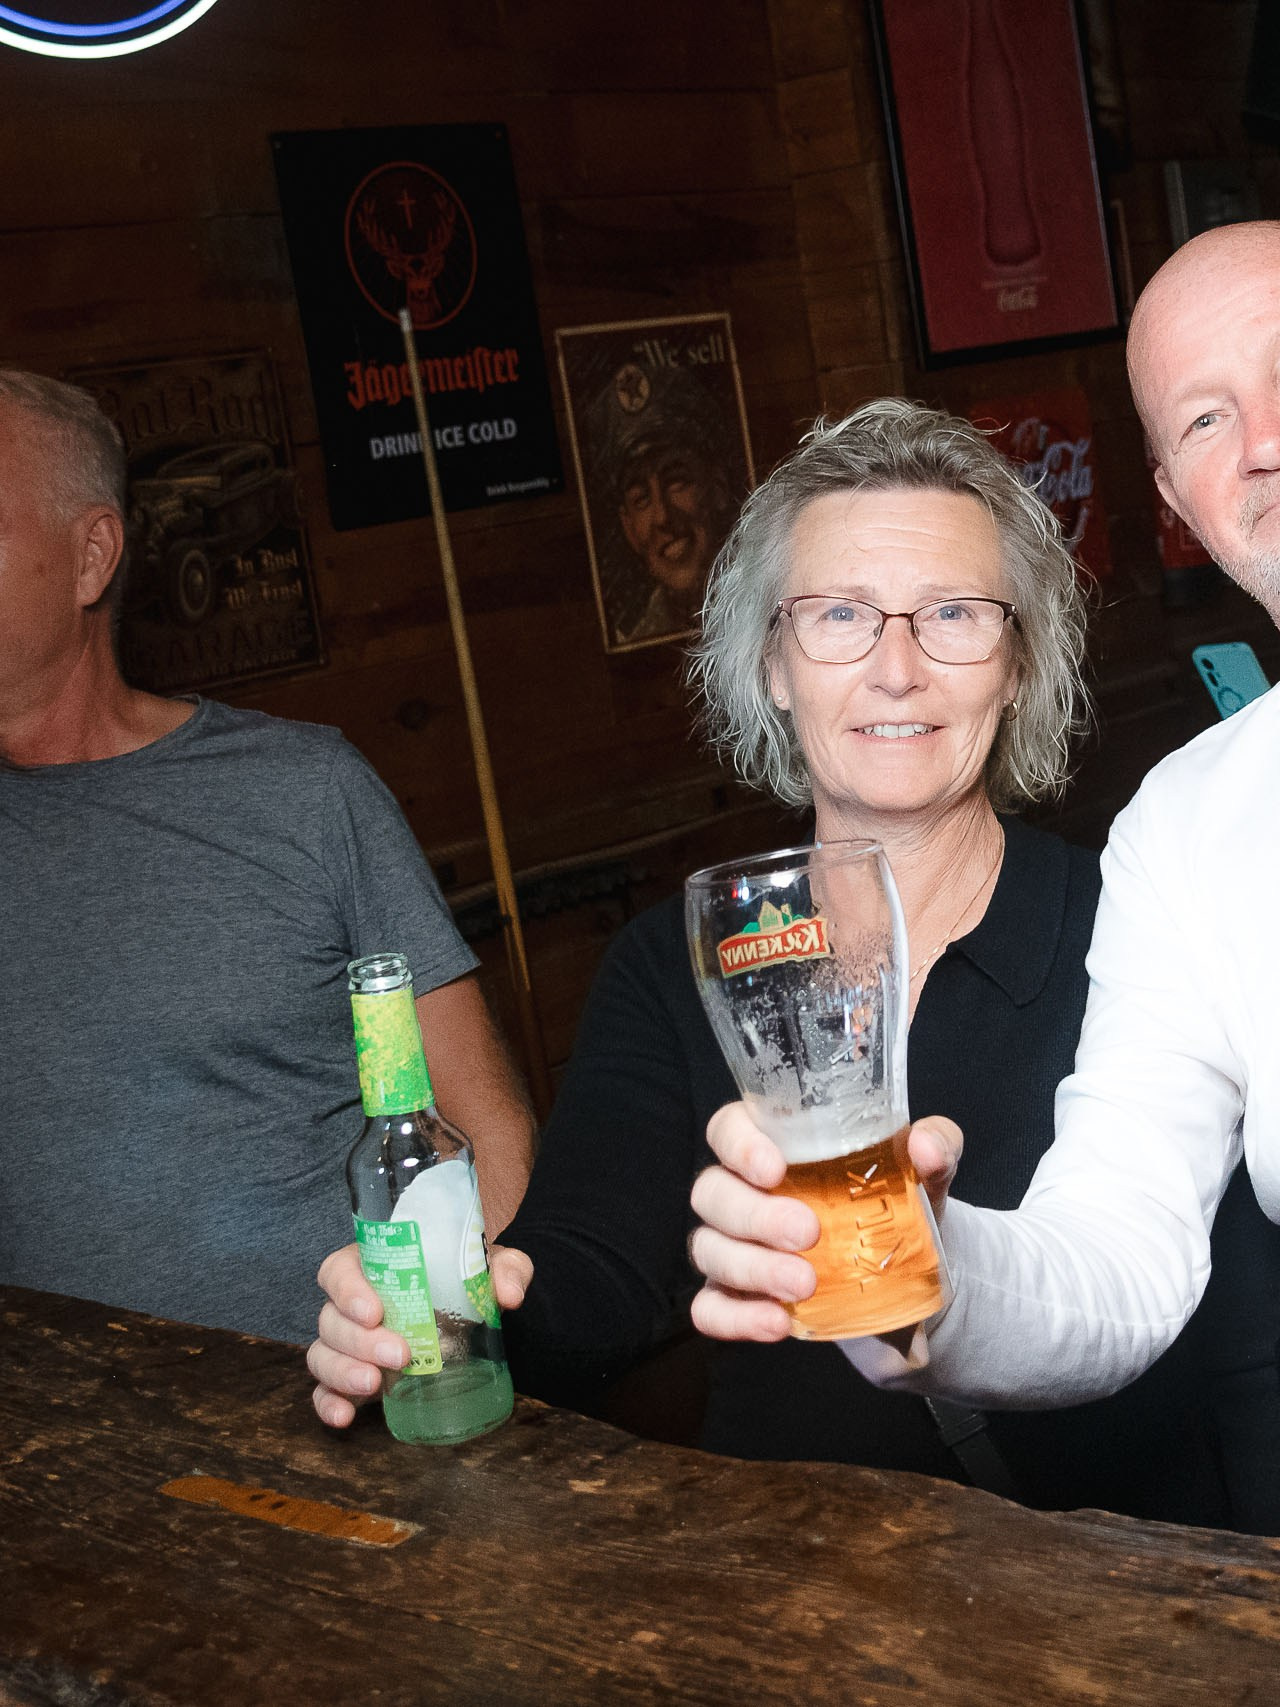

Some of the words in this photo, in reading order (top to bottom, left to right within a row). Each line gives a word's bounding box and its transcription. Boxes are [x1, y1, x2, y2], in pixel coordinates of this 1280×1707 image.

[687, 335, 726, 365] sell
[369, 431, 429, 460] DRIN
[434, 424, 466, 450] ICE
[468, 418, 518, 444] COLD
